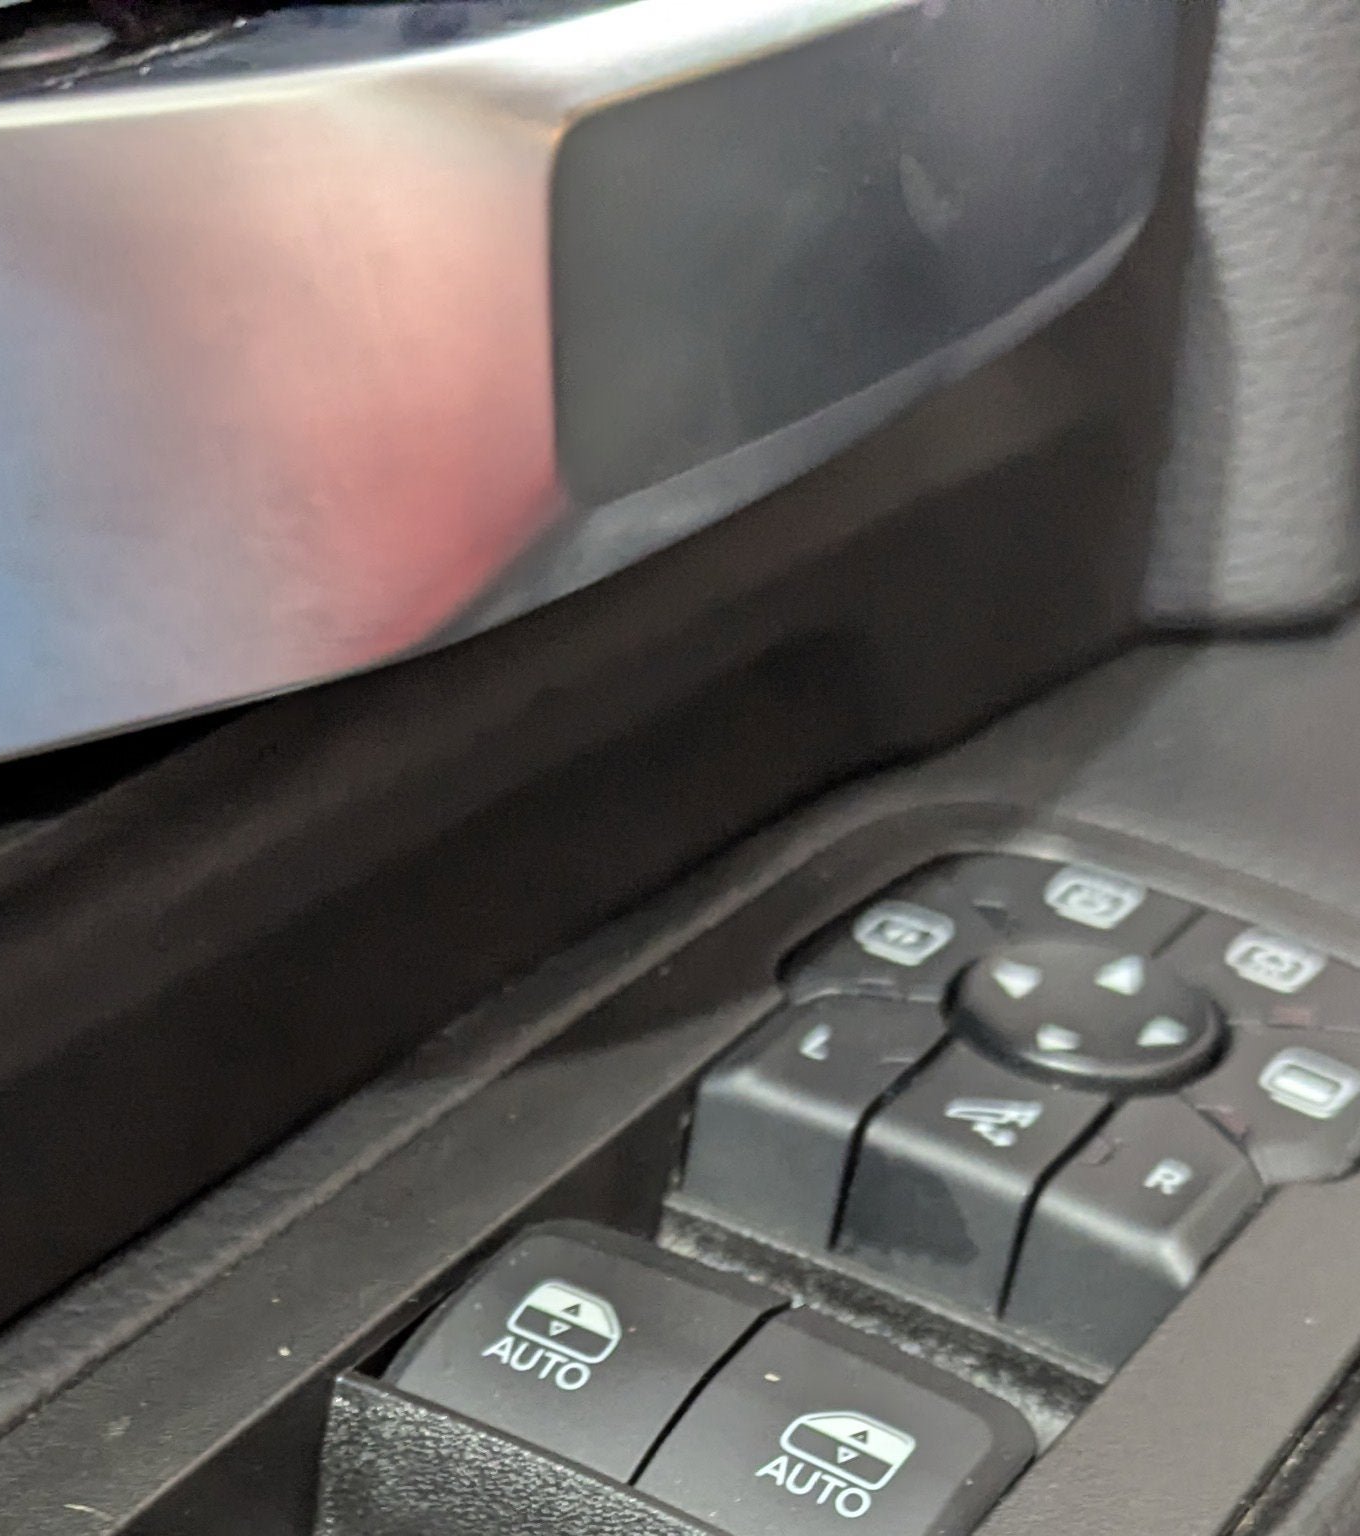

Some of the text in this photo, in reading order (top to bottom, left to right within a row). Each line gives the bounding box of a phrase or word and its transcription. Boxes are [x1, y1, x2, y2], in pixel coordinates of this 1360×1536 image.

[799, 1022, 832, 1061] L
[1142, 1157, 1193, 1195] R
[481, 1335, 592, 1391] AUTO
[754, 1454, 873, 1519] AUTO
